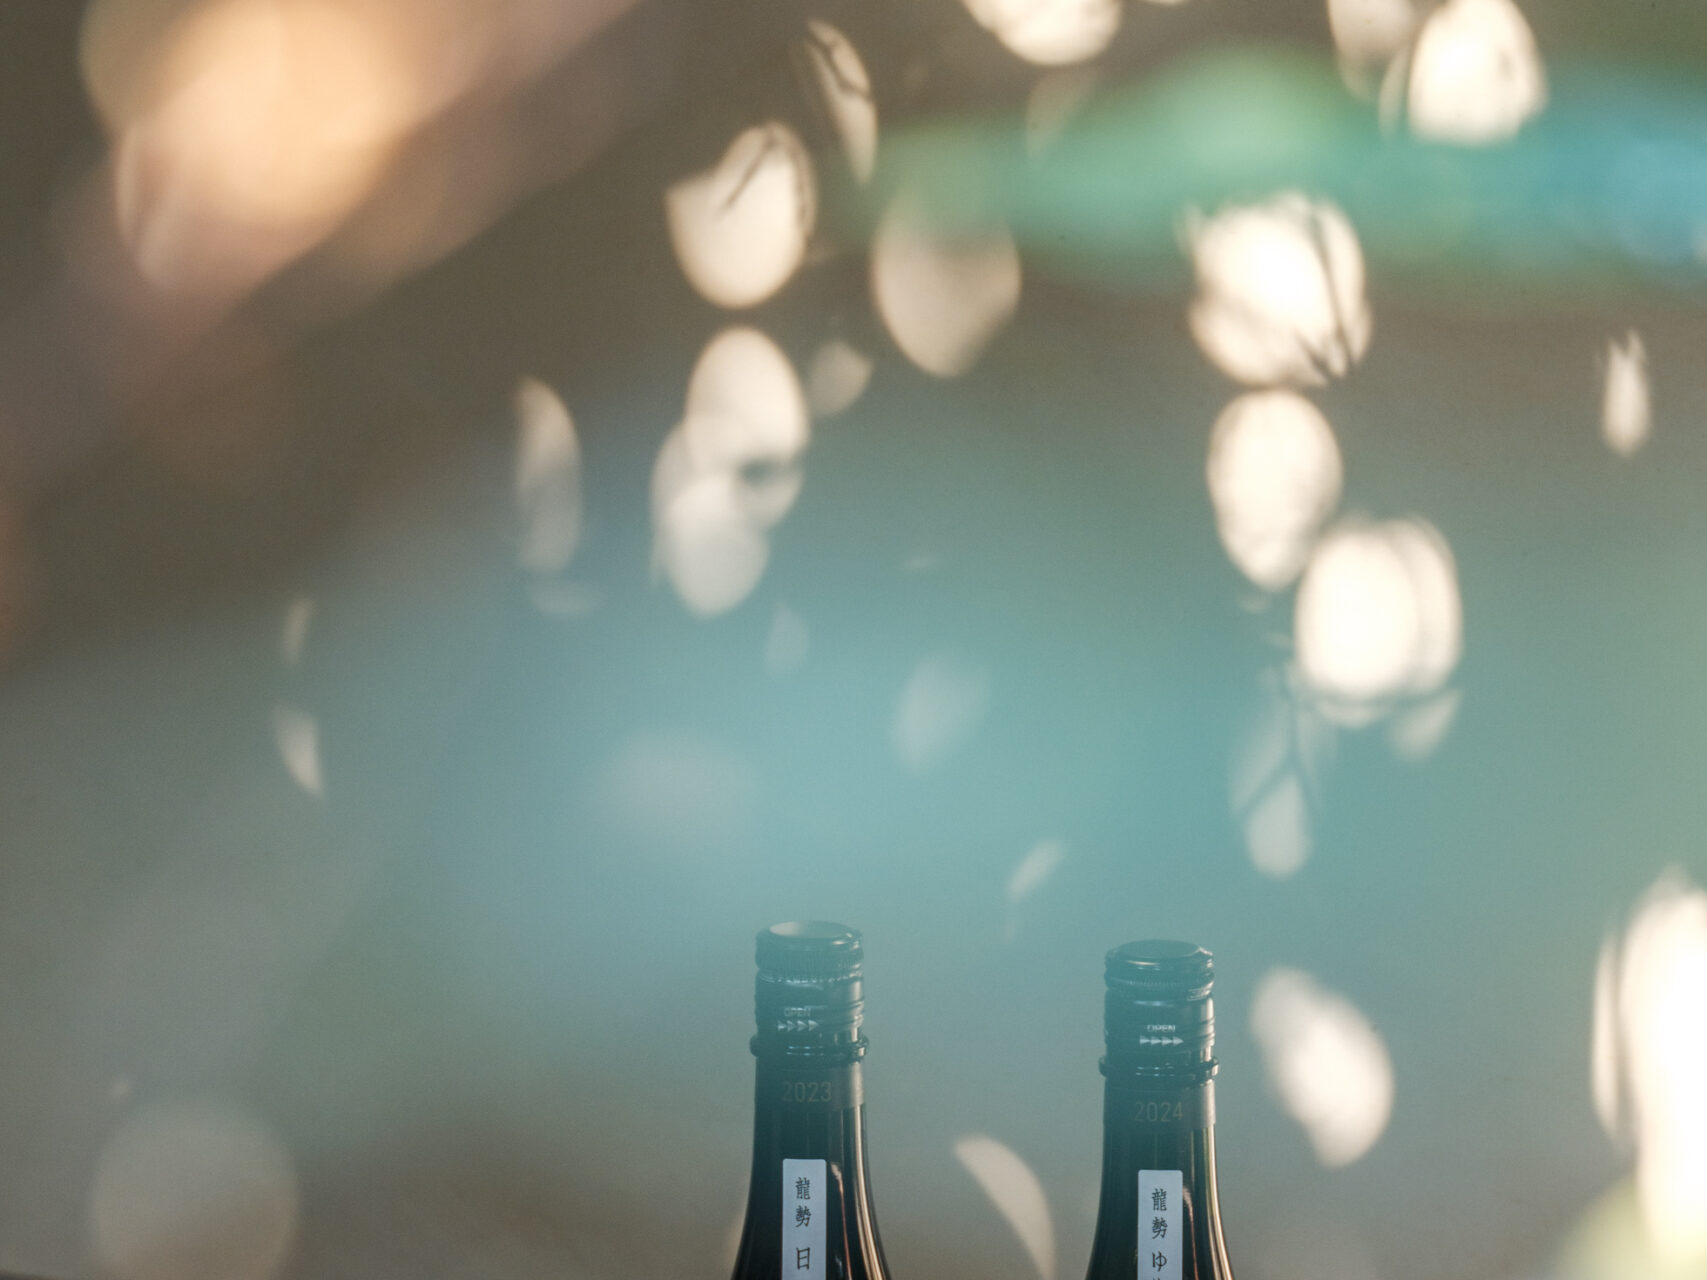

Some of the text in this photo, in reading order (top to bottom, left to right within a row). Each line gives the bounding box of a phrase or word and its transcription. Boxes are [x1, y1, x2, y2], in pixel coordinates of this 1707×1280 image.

[1146, 1024, 1176, 1033] OPEN
[782, 1081, 833, 1103] 2023
[1134, 1101, 1185, 1122] 2024
[795, 1177, 812, 1228] 龍勢
[1151, 1188, 1168, 1240] 龍勢
